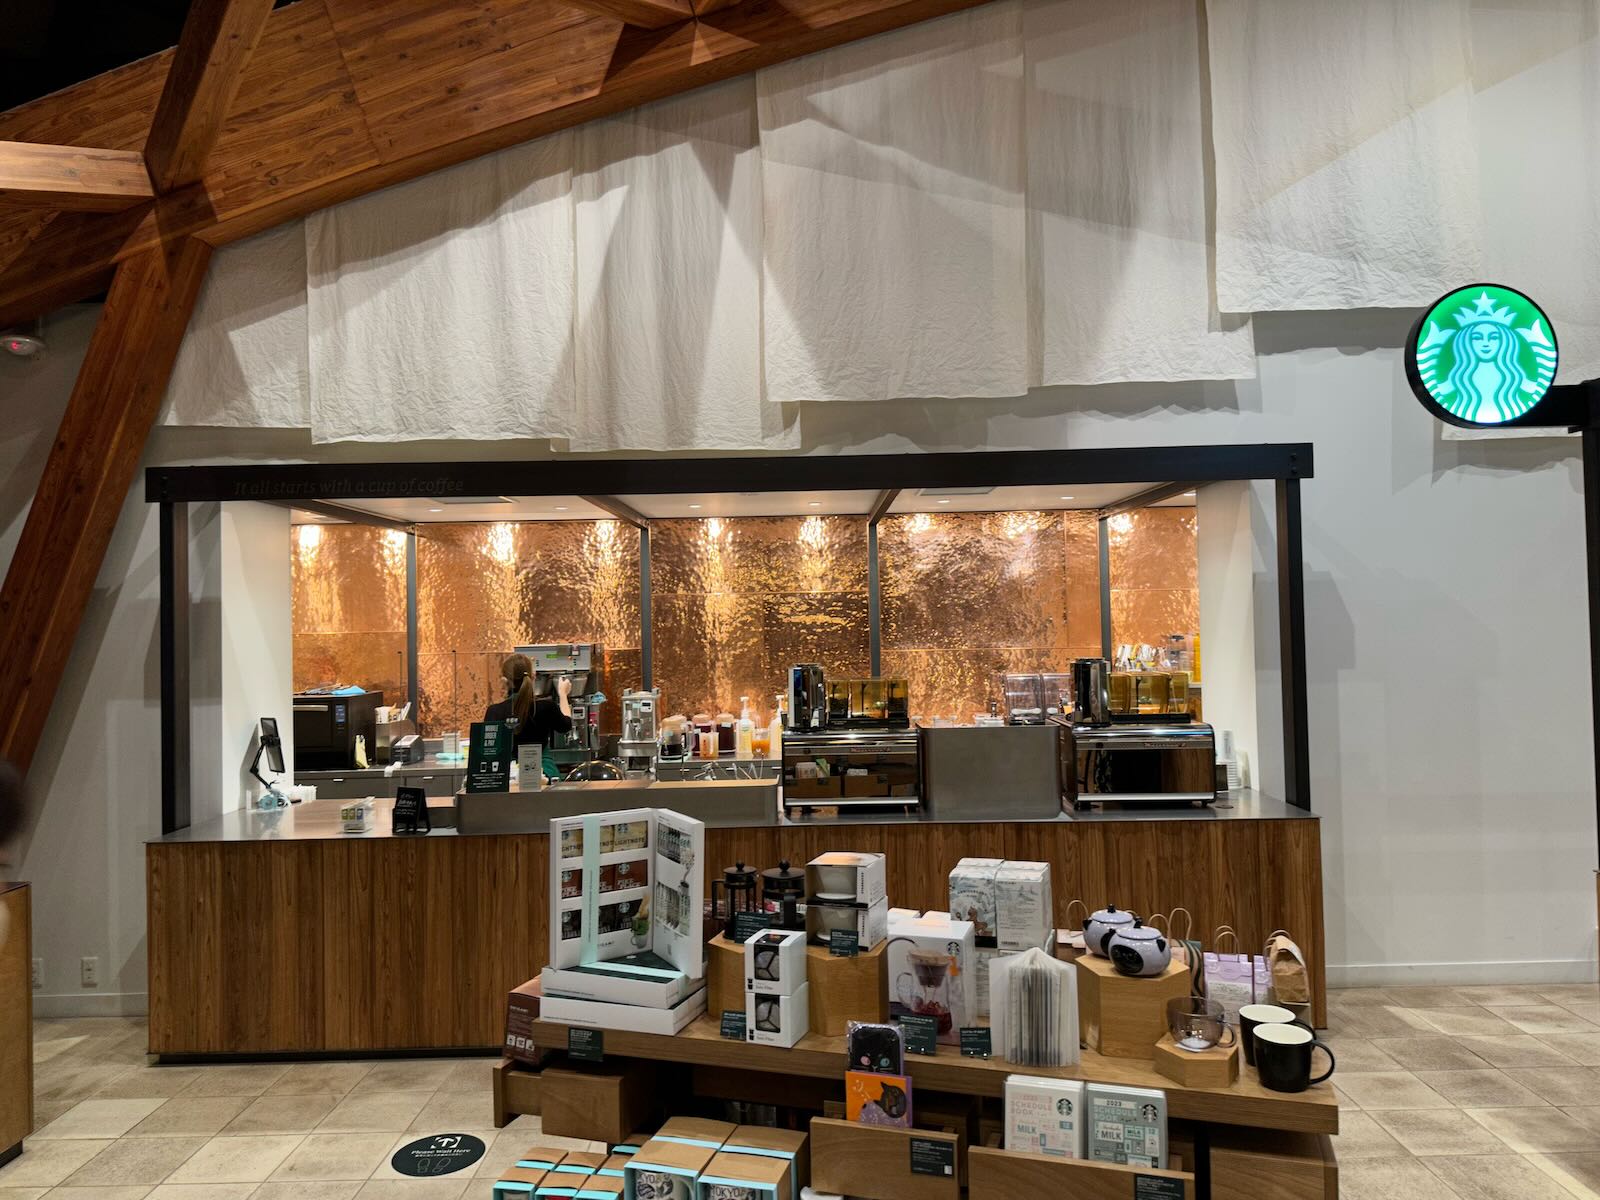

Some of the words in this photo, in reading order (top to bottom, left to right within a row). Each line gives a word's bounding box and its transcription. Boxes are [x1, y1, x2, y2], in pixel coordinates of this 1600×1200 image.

[233, 482, 246, 495] It
[248, 481, 270, 495] all
[272, 481, 316, 495] starts
[319, 479, 352, 493] with
[354, 482, 366, 493] a
[368, 480, 396, 496] cup
[399, 478, 418, 496] of
[419, 477, 464, 494] coffee
[1017, 1124, 1037, 1134] MILK
[1101, 1130, 1121, 1140] MILK
